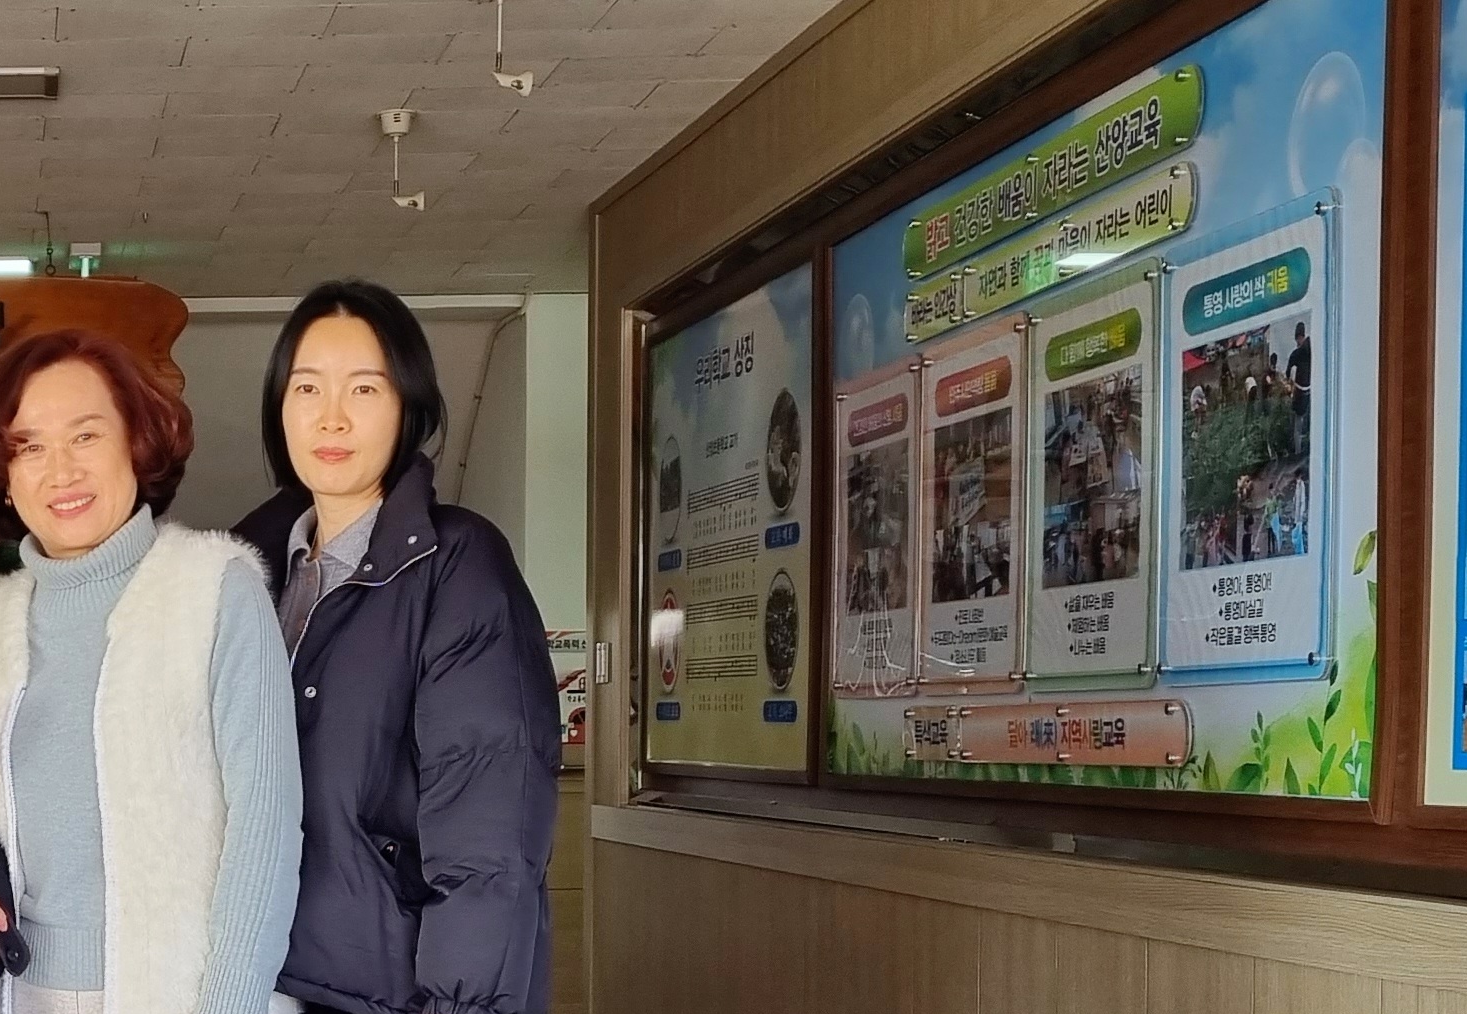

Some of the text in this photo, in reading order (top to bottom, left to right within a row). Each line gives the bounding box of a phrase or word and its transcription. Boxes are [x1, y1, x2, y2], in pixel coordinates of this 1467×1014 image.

[953, 190, 994, 249] 건강한
[996, 162, 1038, 222] 배움이
[1040, 144, 1089, 200] 자라는
[1093, 96, 1163, 179] 산양교육
[1094, 208, 1131, 247] 자라는
[1134, 183, 1174, 231] 어린이
[1203, 290, 1224, 319] 통영
[1224, 279, 1253, 312] 사랑의
[694, 329, 755, 392] 우리학교 상징
[1218, 576, 1245, 605] 통영아,
[1224, 599, 1264, 622] 통영마실길
[1243, 621, 1277, 645] 행복통영
[914, 719, 948, 747] 특색교육
